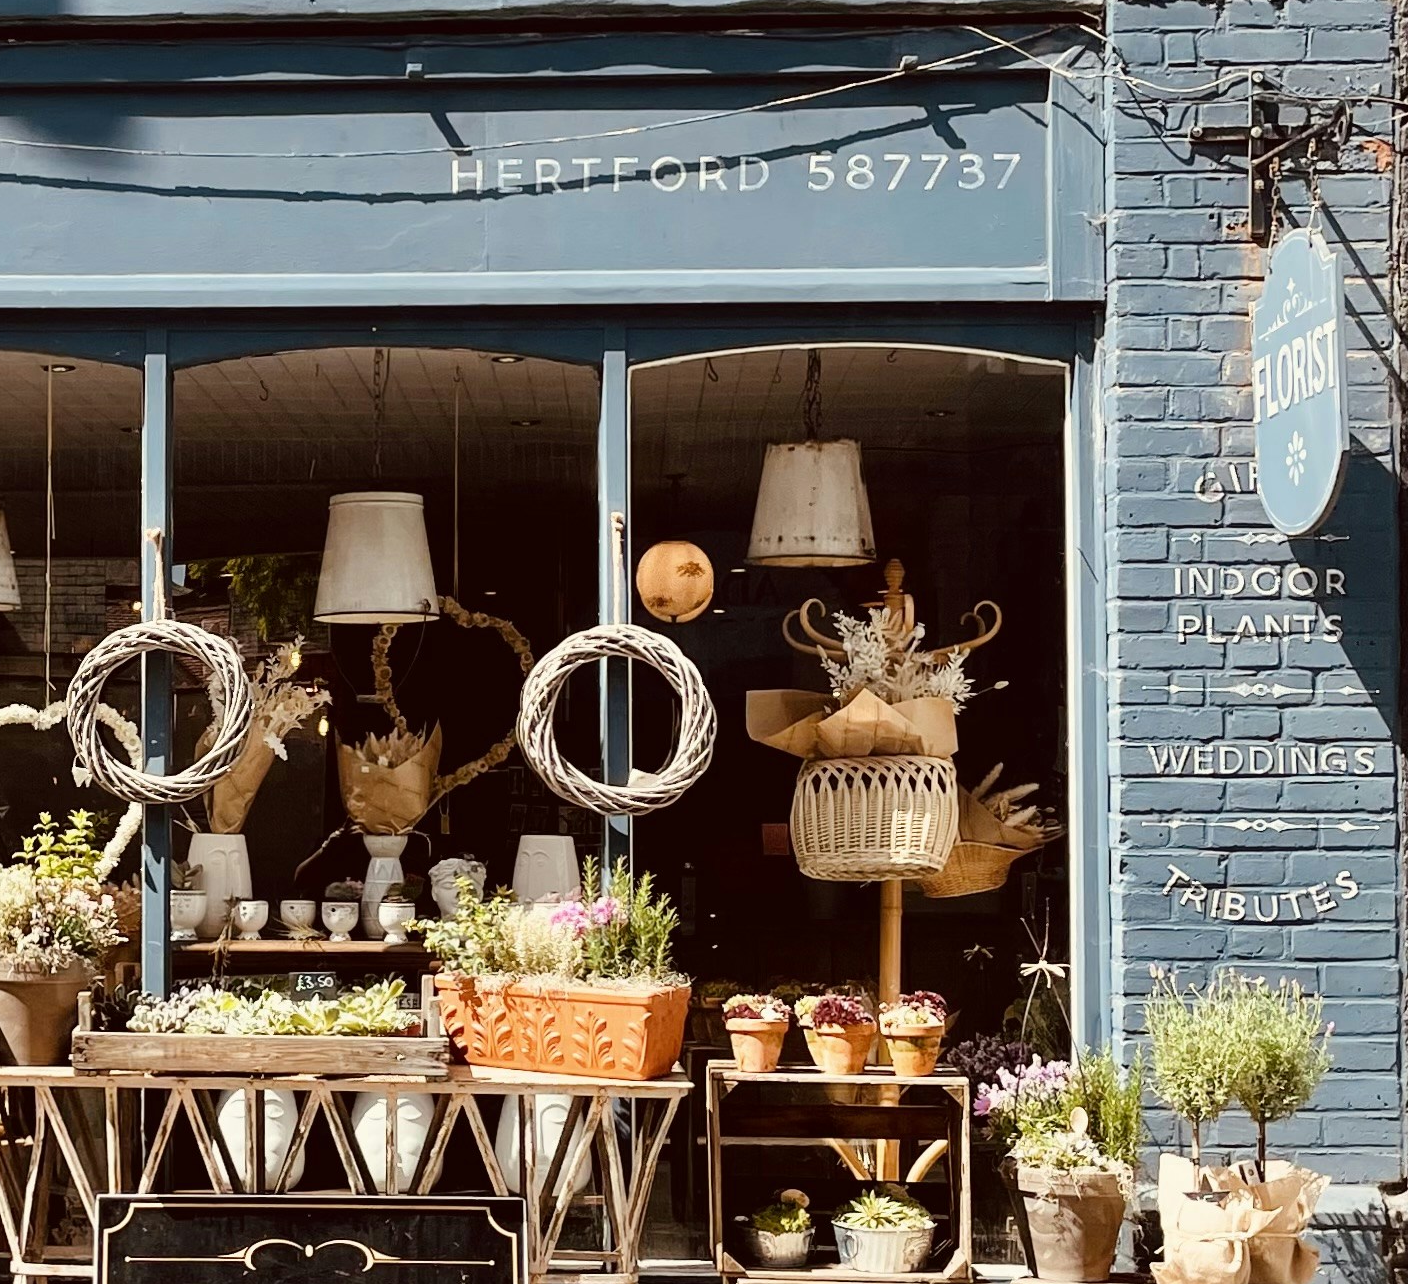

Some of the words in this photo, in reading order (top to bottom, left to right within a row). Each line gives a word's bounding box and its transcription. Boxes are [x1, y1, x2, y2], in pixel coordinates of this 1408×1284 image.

[450, 155, 771, 195] HERTFORD
[806, 153, 1022, 192] 587737
[1253, 319, 1337, 424] FLORIST
[1172, 566, 1348, 598] INDOOR
[1177, 614, 1343, 645] PLANTS
[1148, 745, 1376, 777] WEDDINGS
[1162, 865, 1360, 924] TRIBUTES
[295, 974, 334, 992] £3.50
